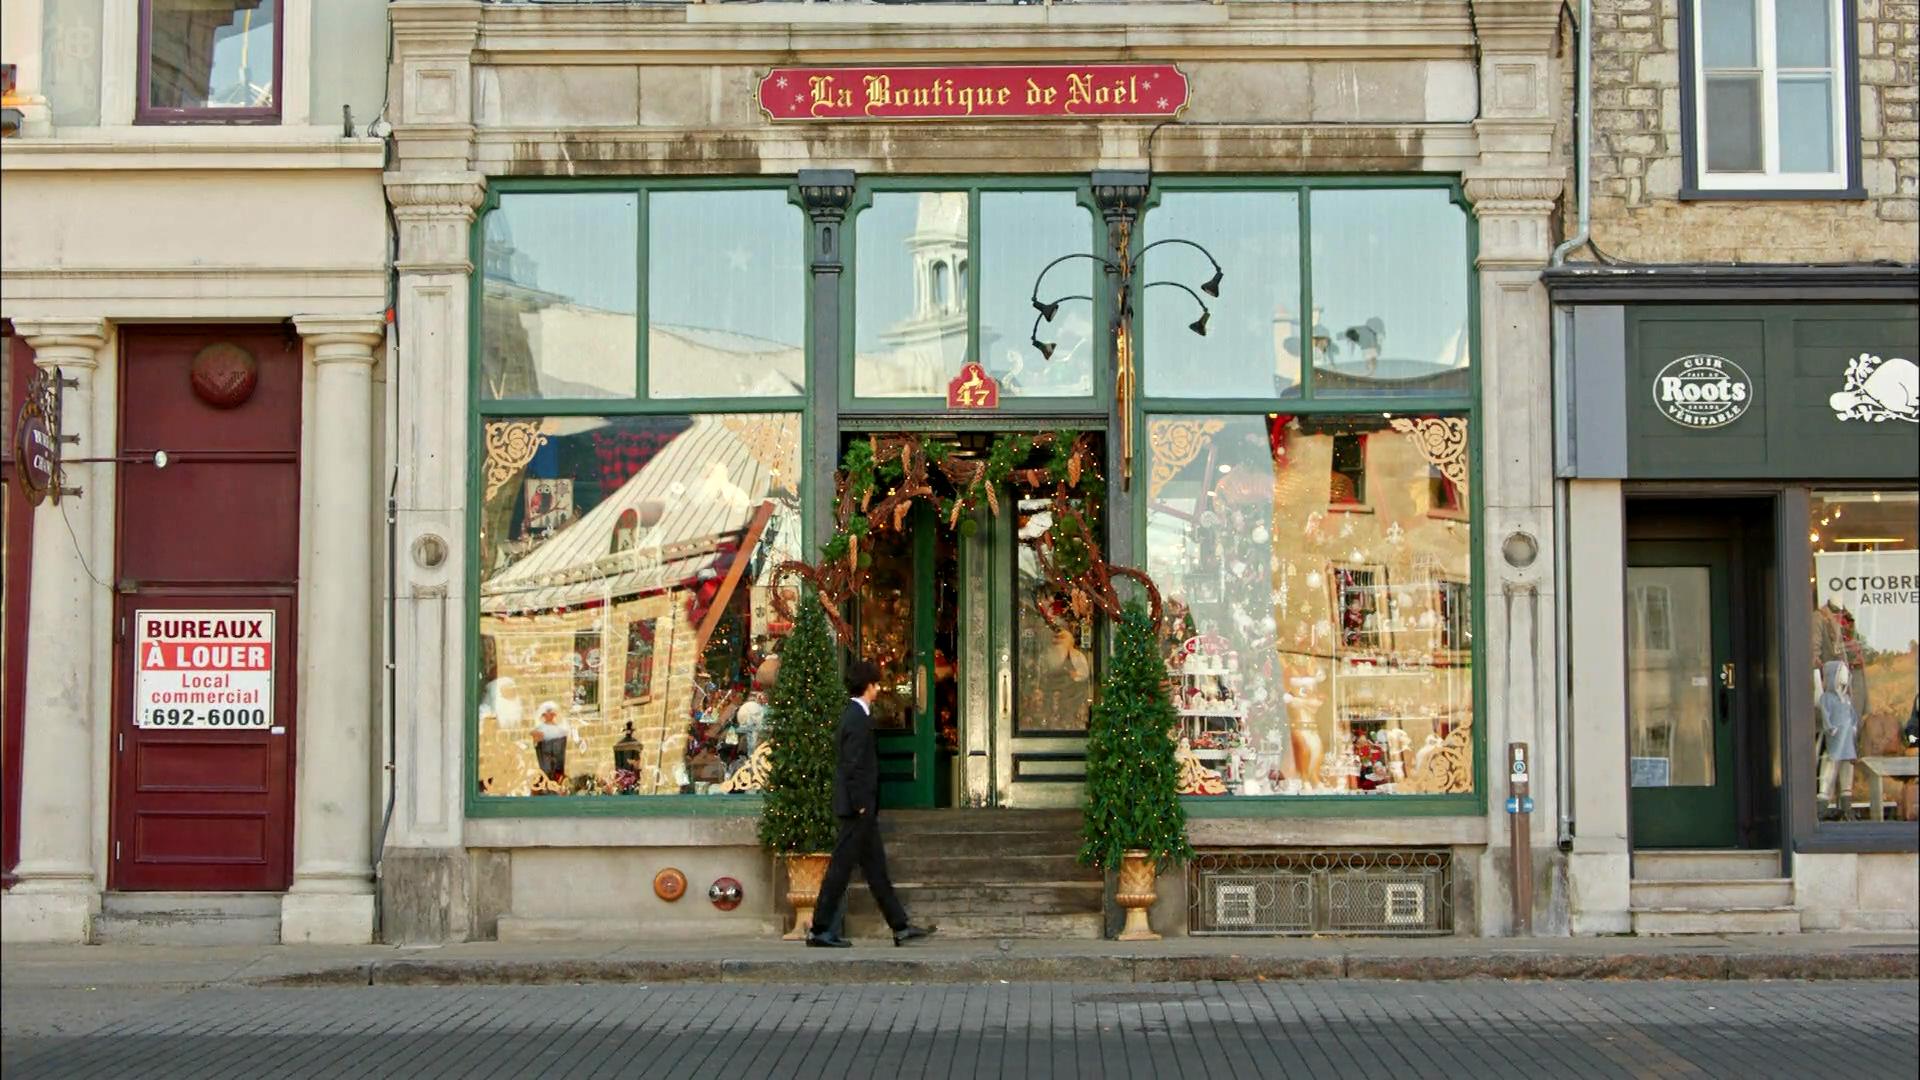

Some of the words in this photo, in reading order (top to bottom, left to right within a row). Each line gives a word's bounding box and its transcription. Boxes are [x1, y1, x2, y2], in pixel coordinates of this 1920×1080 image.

[808, 75, 853, 118] La
[863, 74, 1011, 117] Boutique
[1026, 77, 1058, 106] de
[1064, 73, 1137, 114] Noël
[1683, 358, 1723, 368] CUIR
[1661, 376, 1746, 402] Roots
[956, 390, 991, 406] 47
[1860, 591, 1919, 605] ARRIVE
[147, 620, 262, 638] BUREAUX
[146, 640, 165, 667] À
[176, 646, 265, 667] LOUER
[182, 673, 230, 688] Local
[151, 689, 259, 703] commercial
[152, 709, 265, 725] 692-6000
